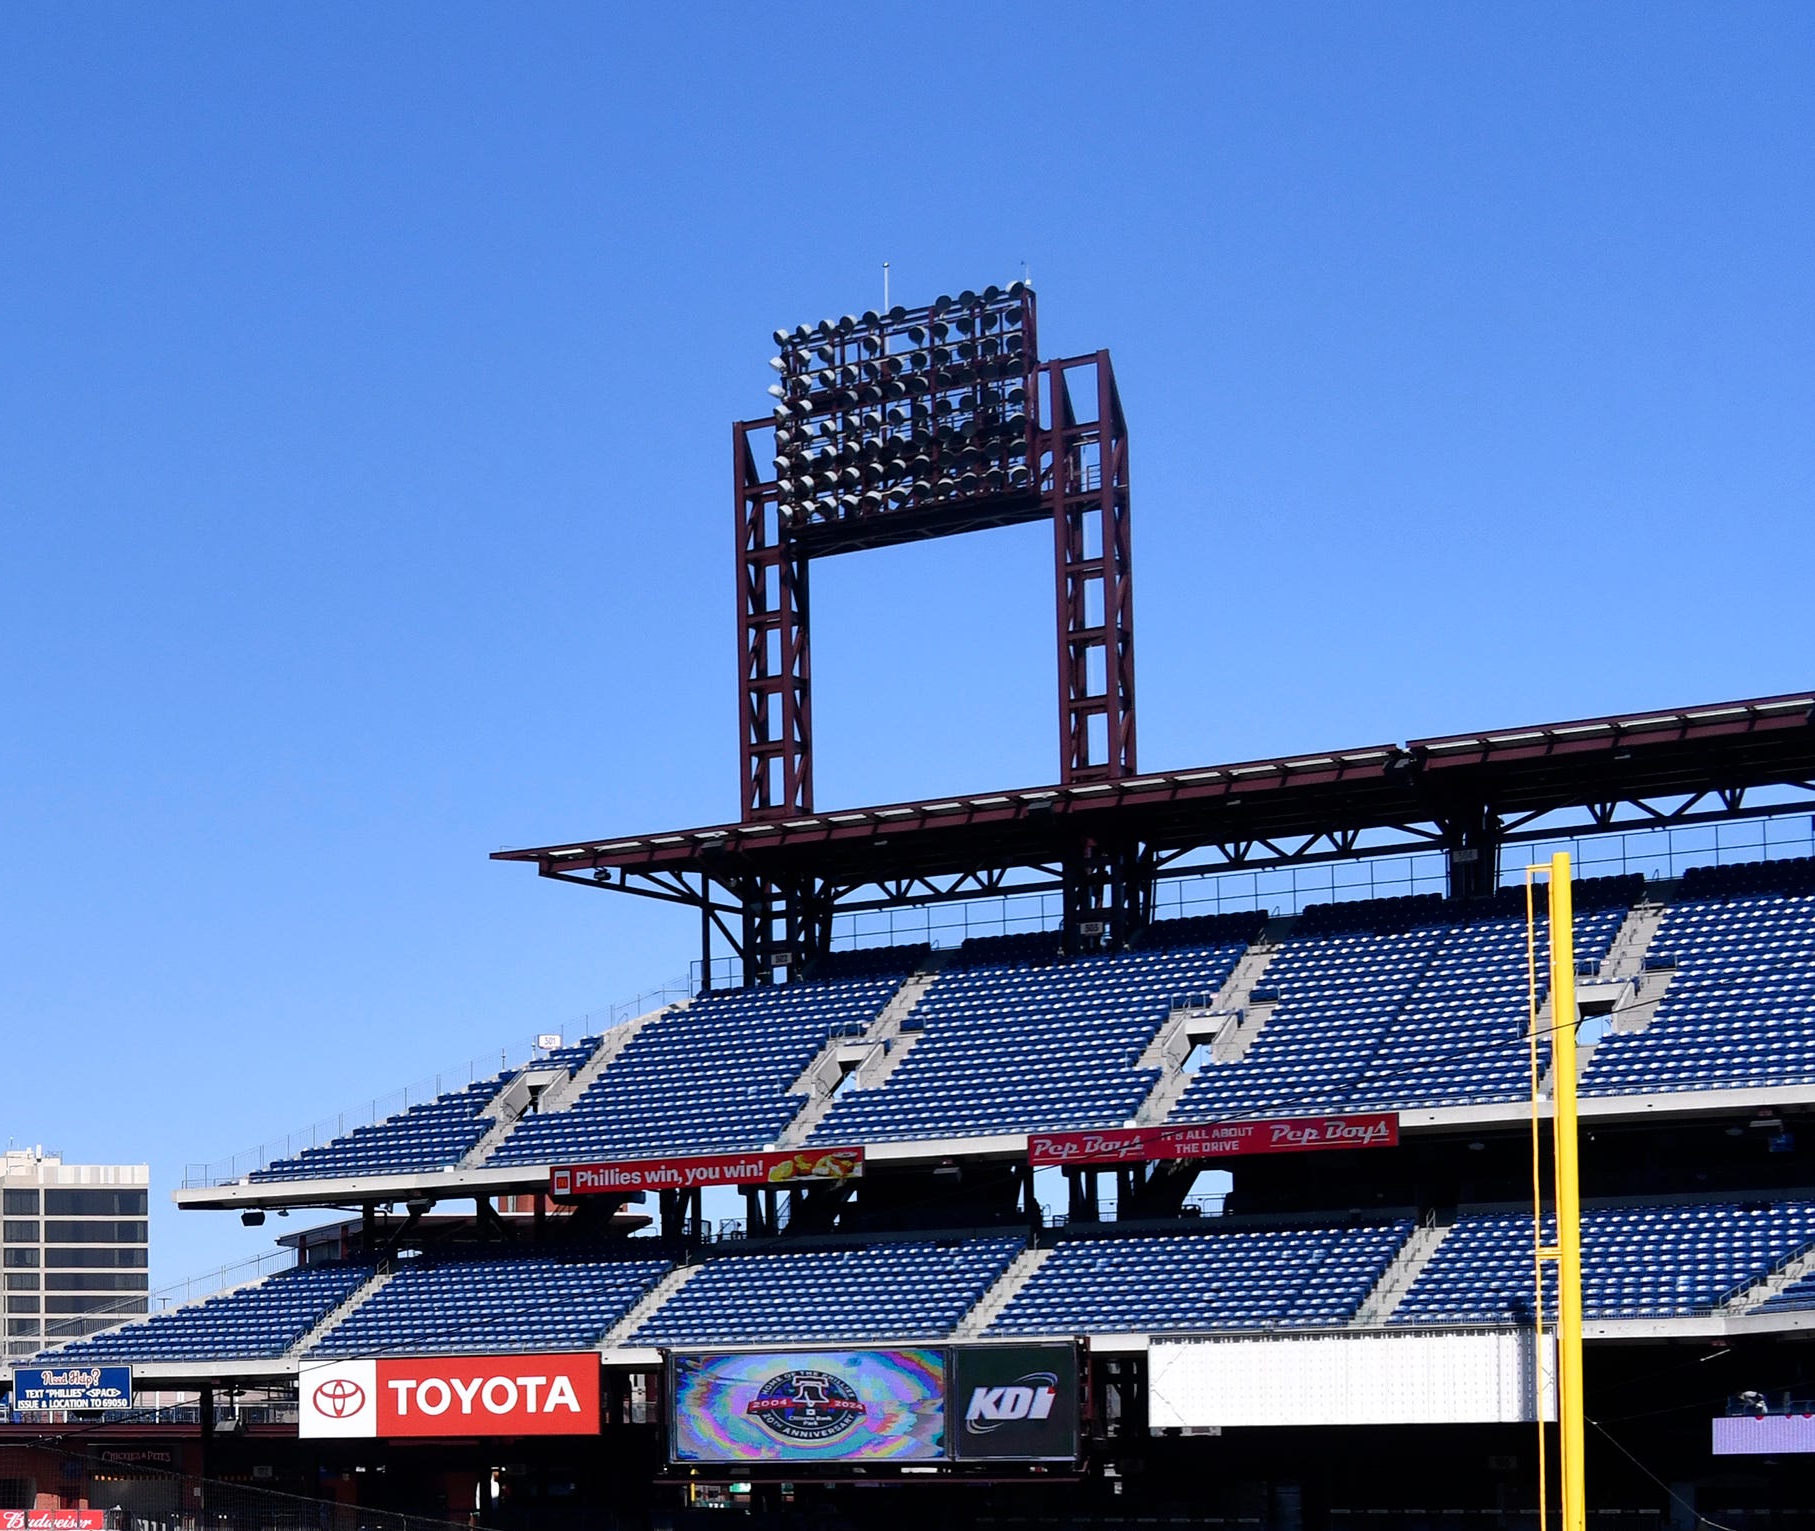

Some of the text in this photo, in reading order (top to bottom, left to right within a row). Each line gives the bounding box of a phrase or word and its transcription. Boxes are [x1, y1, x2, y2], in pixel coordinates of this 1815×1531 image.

[1185, 1129, 1209, 1141] ALL
[1211, 1126, 1254, 1139] ABOUT
[1270, 1120, 1389, 1144] Pep Boys
[1033, 1135, 1145, 1159] Pep Boys
[1174, 1140, 1240, 1154] THE DRIVE
[575, 1160, 764, 1188] Phillies win, you win!
[41, 1368, 101, 1389] Need Help?
[18, 1398, 128, 1408] ISSUE & LOCATION TO 69050
[25, 1389, 44, 1398] TEXT
[388, 1375, 581, 1416] TOYOTA
[965, 1384, 1057, 1421] KDI
[4, 1511, 93, 1529] Budweiser
